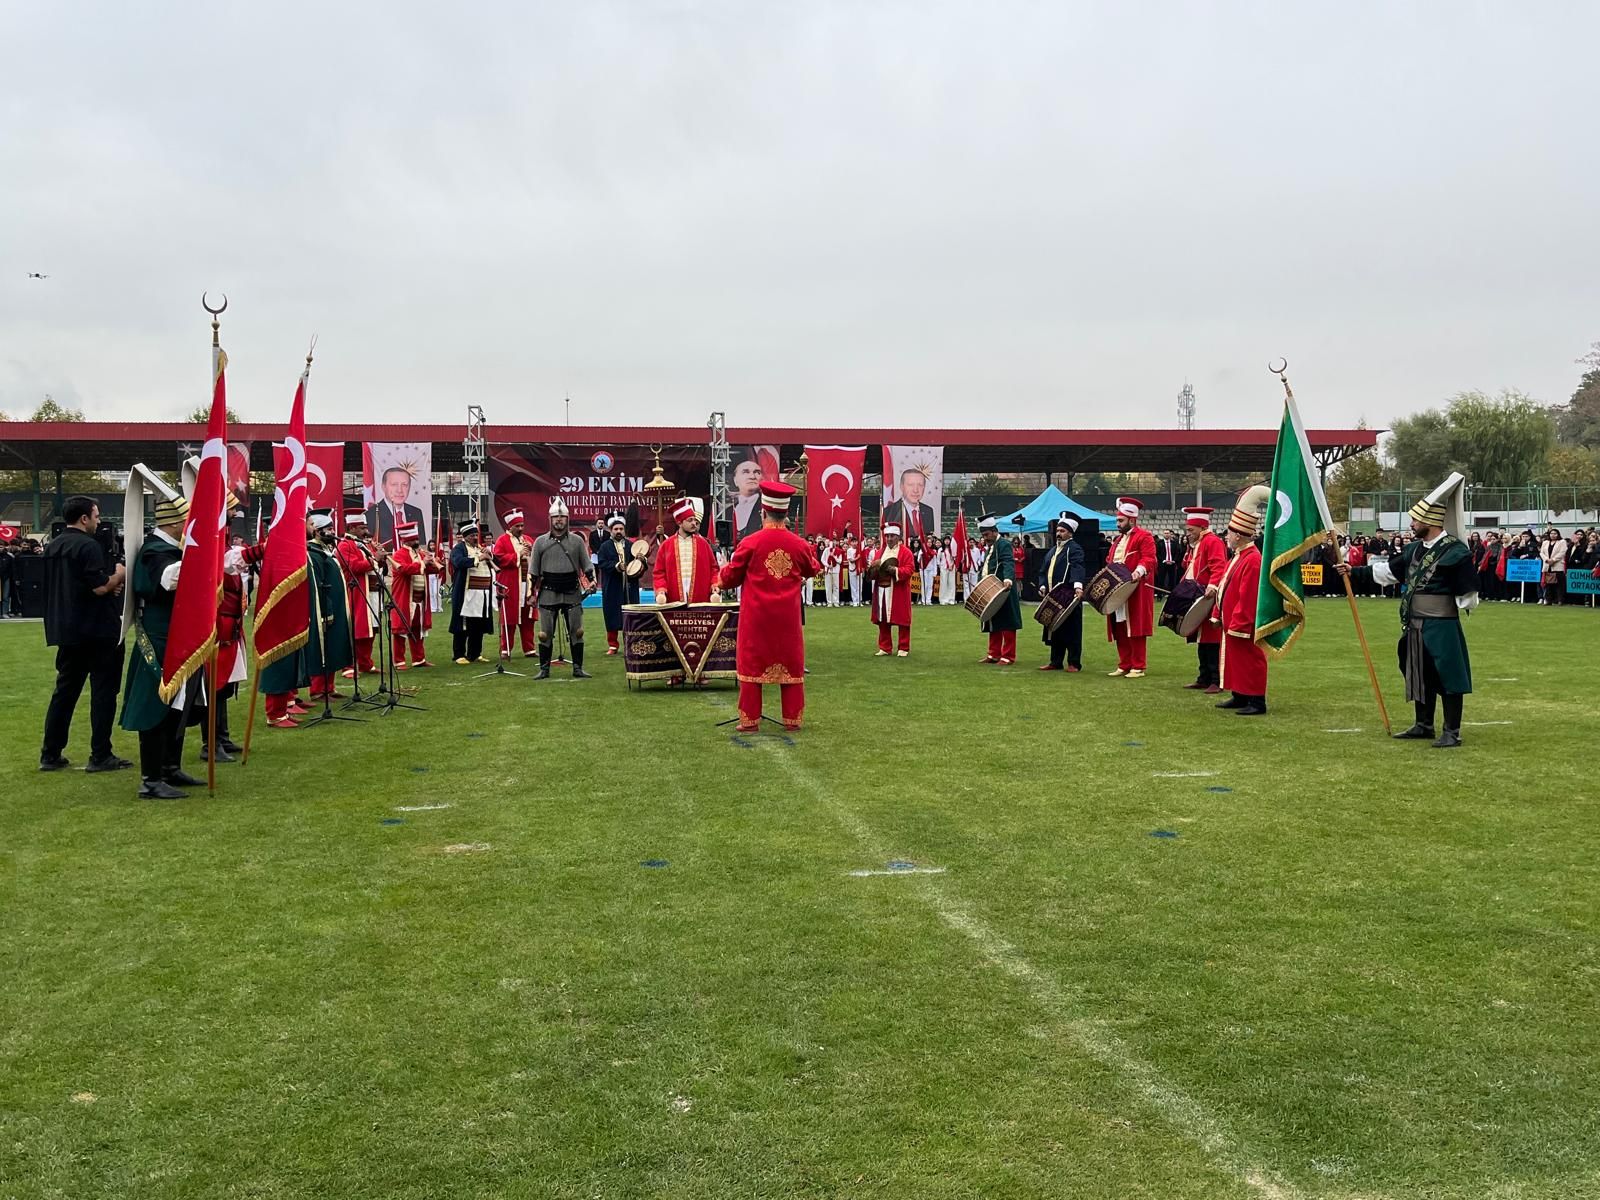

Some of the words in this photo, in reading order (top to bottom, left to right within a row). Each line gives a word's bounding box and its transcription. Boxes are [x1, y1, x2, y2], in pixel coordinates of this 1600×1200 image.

[559, 476, 584, 493] 29
[588, 472, 644, 493] EKİM
[573, 507, 600, 516] KUTLU
